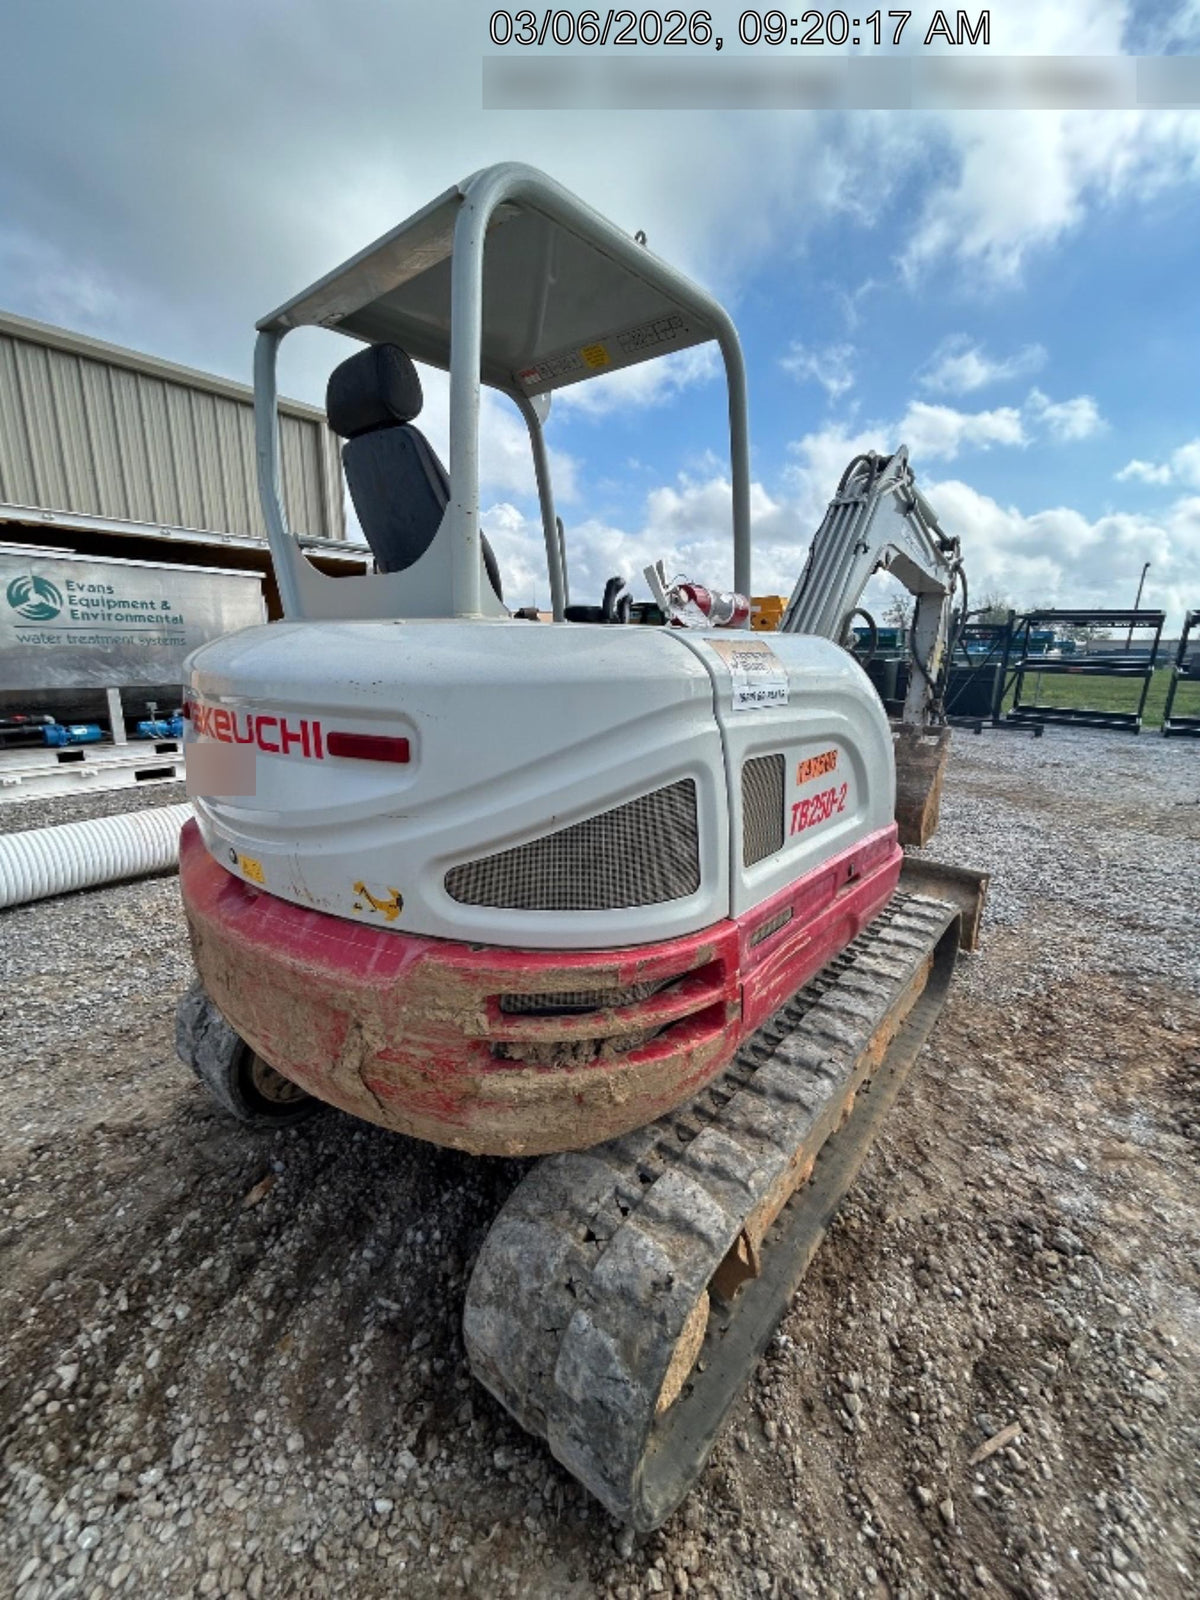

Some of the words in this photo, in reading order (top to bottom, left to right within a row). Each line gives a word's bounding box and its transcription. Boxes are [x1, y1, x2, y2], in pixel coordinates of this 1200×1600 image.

[65, 579, 114, 594] Evans
[68, 595, 156, 610] Equipment
[161, 600, 171, 610] &
[70, 609, 184, 625] Environmental
[16, 633, 62, 645] water
[67, 634, 134, 645] treatment
[139, 636, 187, 647] systems
[789, 782, 848, 836] TB250-2
